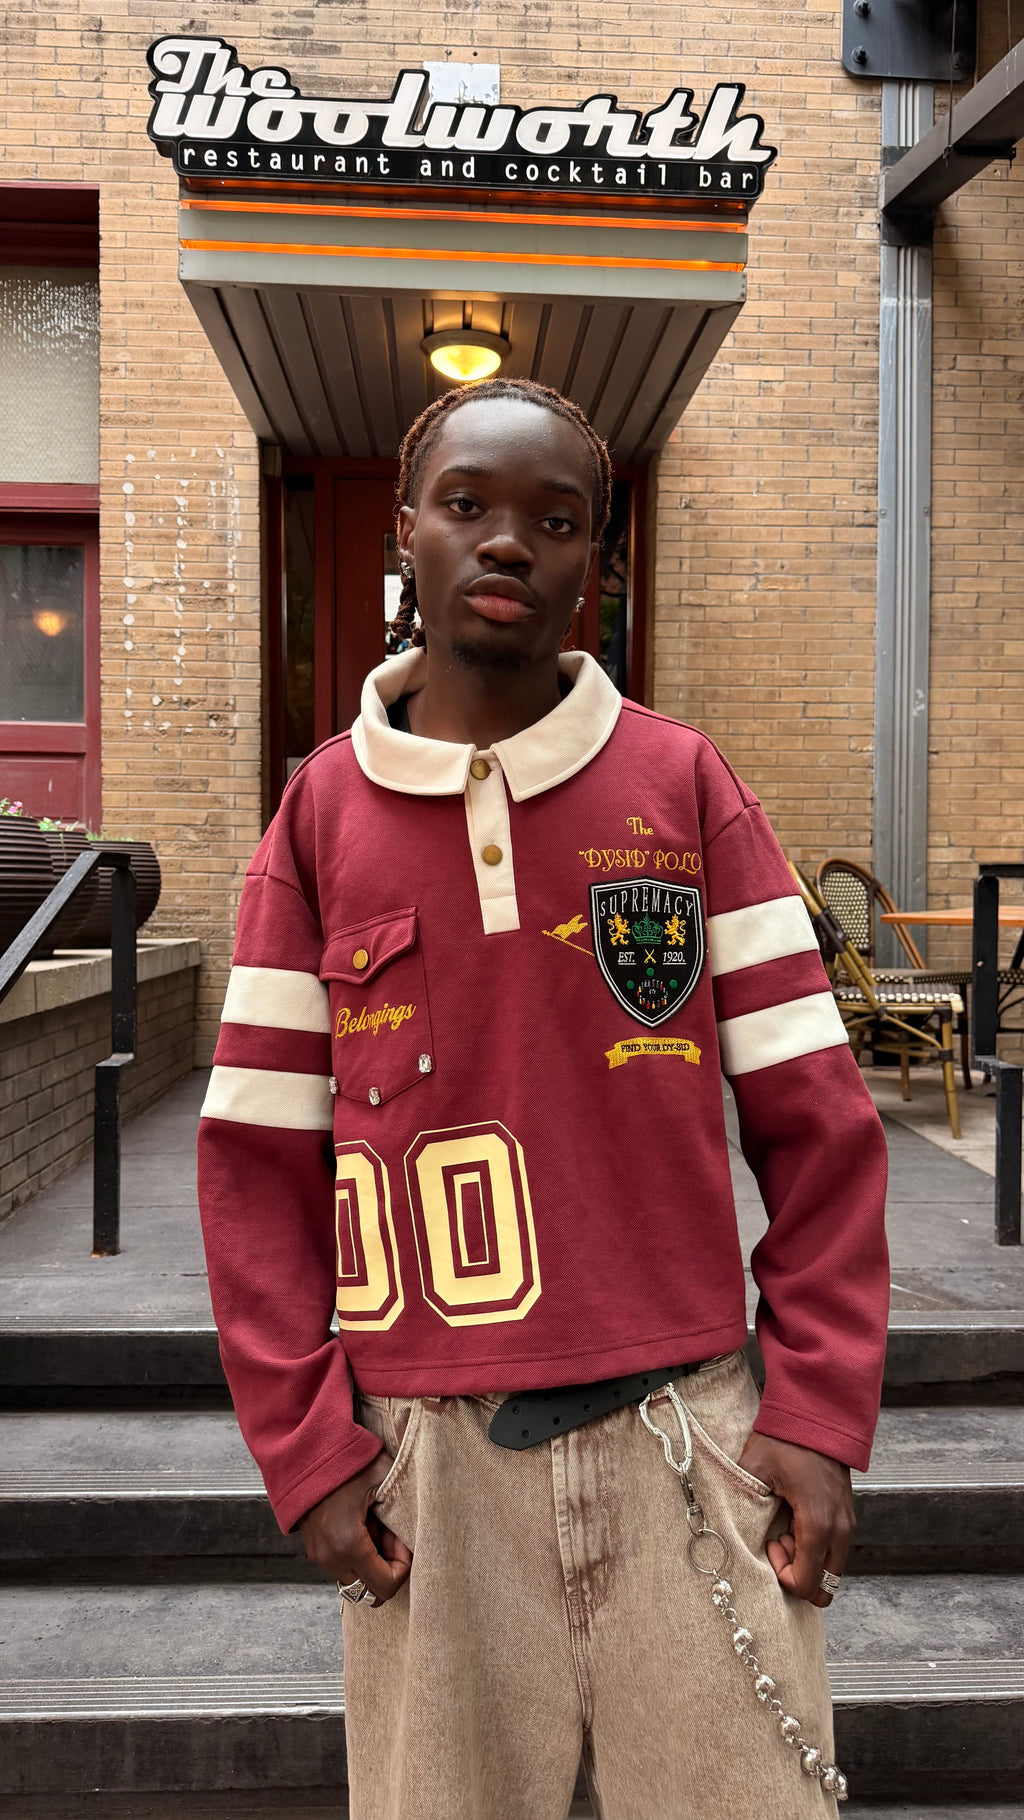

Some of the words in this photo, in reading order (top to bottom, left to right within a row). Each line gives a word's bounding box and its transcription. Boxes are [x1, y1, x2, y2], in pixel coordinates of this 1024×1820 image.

[153, 38, 296, 99] The
[183, 147, 391, 174] restaurant
[419, 156, 476, 179] and
[504, 160, 667, 187] cocktail
[699, 166, 754, 189] bar
[626, 816, 654, 836] The
[653, 849, 702, 875] POLO
[600, 886, 694, 917] SUPREMACY
[617, 951, 637, 963] EST.
[334, 1002, 417, 1040] Belongings
[621, 1043, 641, 1053] FIND
